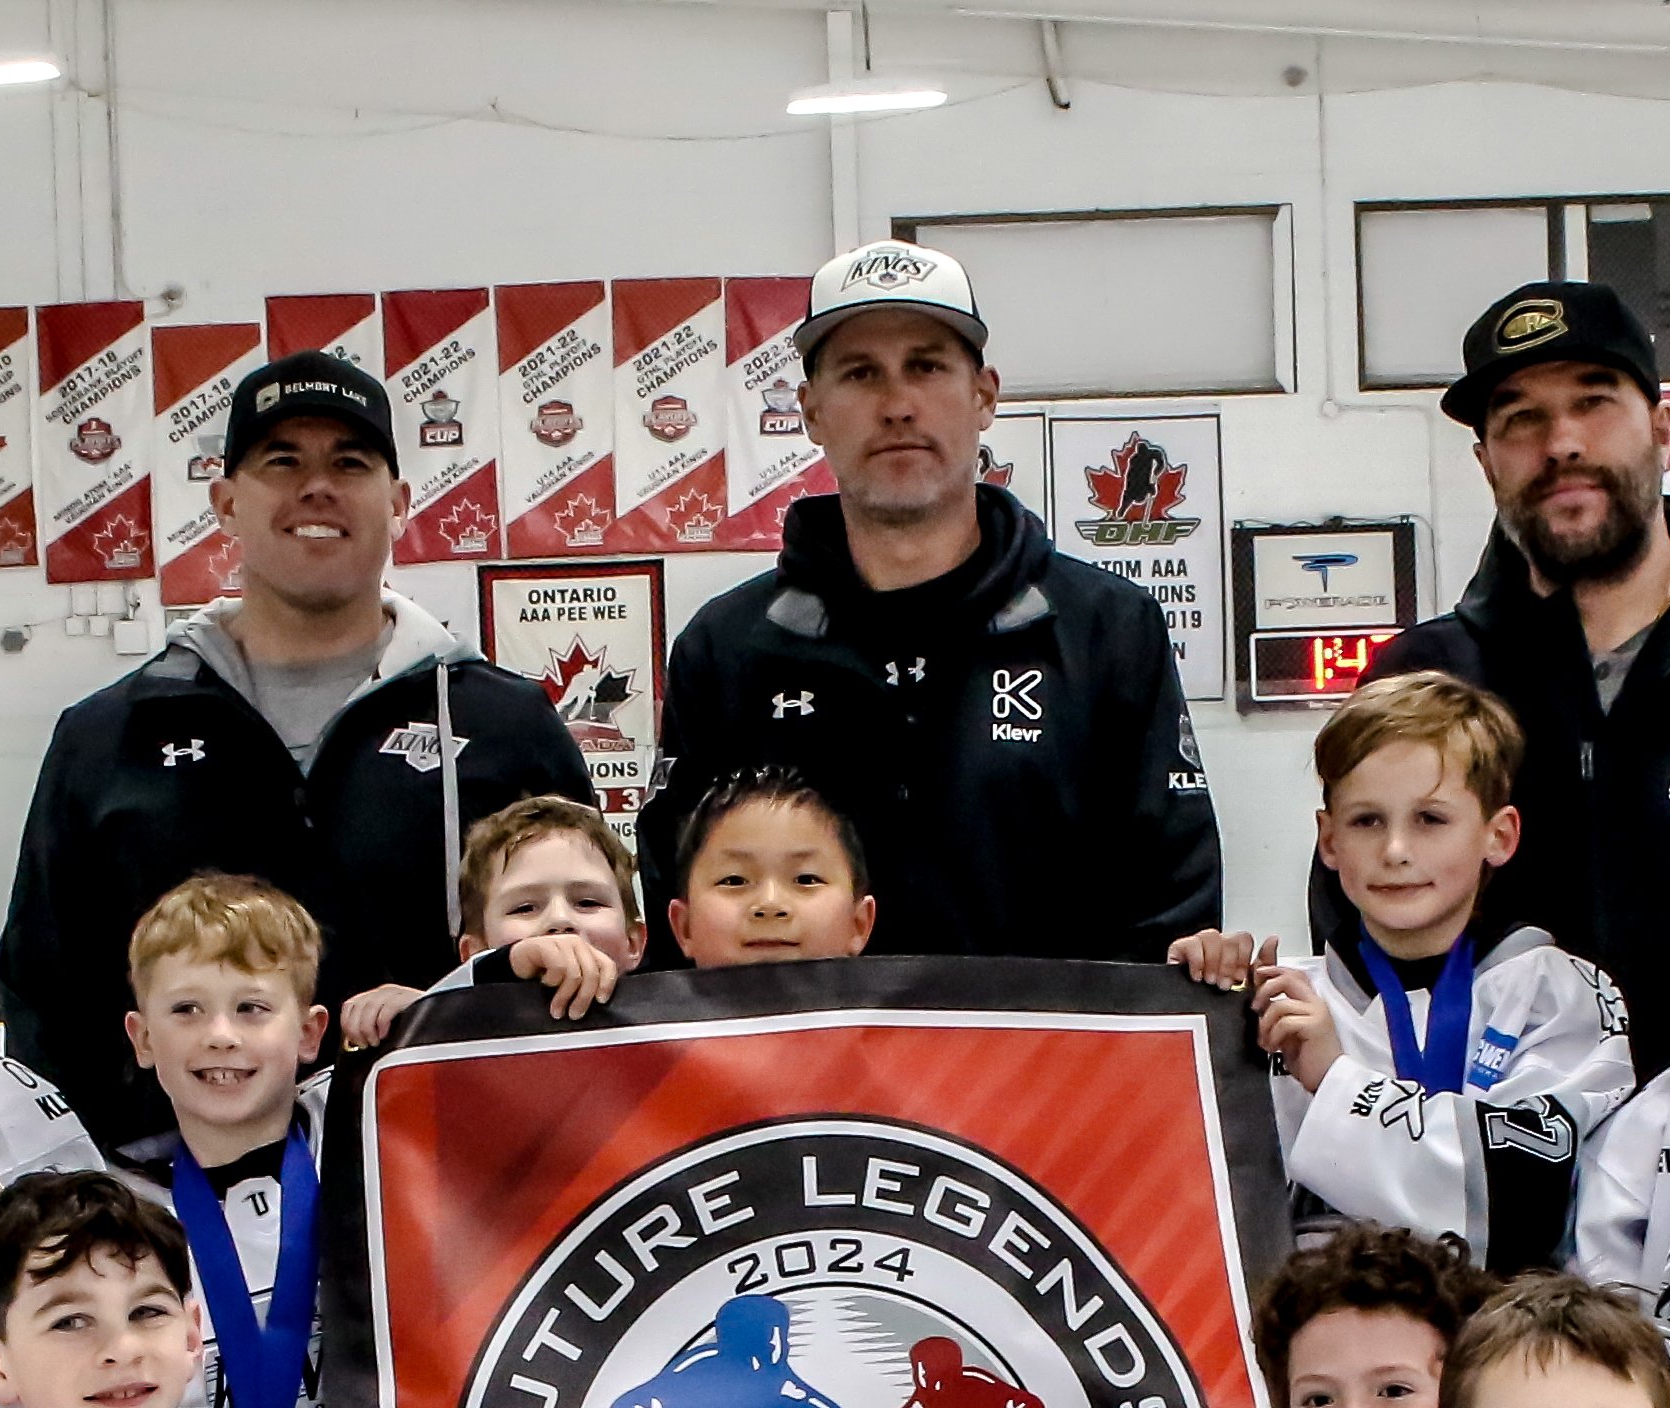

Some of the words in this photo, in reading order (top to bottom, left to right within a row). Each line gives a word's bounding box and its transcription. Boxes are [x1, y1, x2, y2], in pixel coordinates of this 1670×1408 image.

[851, 255, 928, 280] KINGS
[401, 340, 460, 388] 2021-22
[518, 329, 579, 378] 2021-22
[633, 325, 695, 372] 2021-22
[635, 340, 719, 399] CHAMPIONS
[744, 349, 802, 390] CHAMPIO
[58, 351, 117, 399] 2017-18
[62, 365, 143, 425] CHAMPIONS
[403, 348, 476, 403] CHAMPIONS
[522, 342, 602, 404] CHAMPIONS
[168, 393, 233, 443] CHAMPIO
[170, 377, 231, 425] 2017-18
[426, 429, 459, 443] CUP
[763, 419, 800, 432] CUP
[1152, 559, 1188, 578] AAA
[519, 607, 551, 622] AAA
[556, 606, 587, 621] PEE
[592, 604, 627, 620] WEE
[527, 587, 617, 605] ONTARIO
[991, 724, 1042, 743] Klevr
[1168, 772, 1207, 790] KLE
[35, 1091, 74, 1121] KLE
[728, 1237, 916, 1294] 2024
